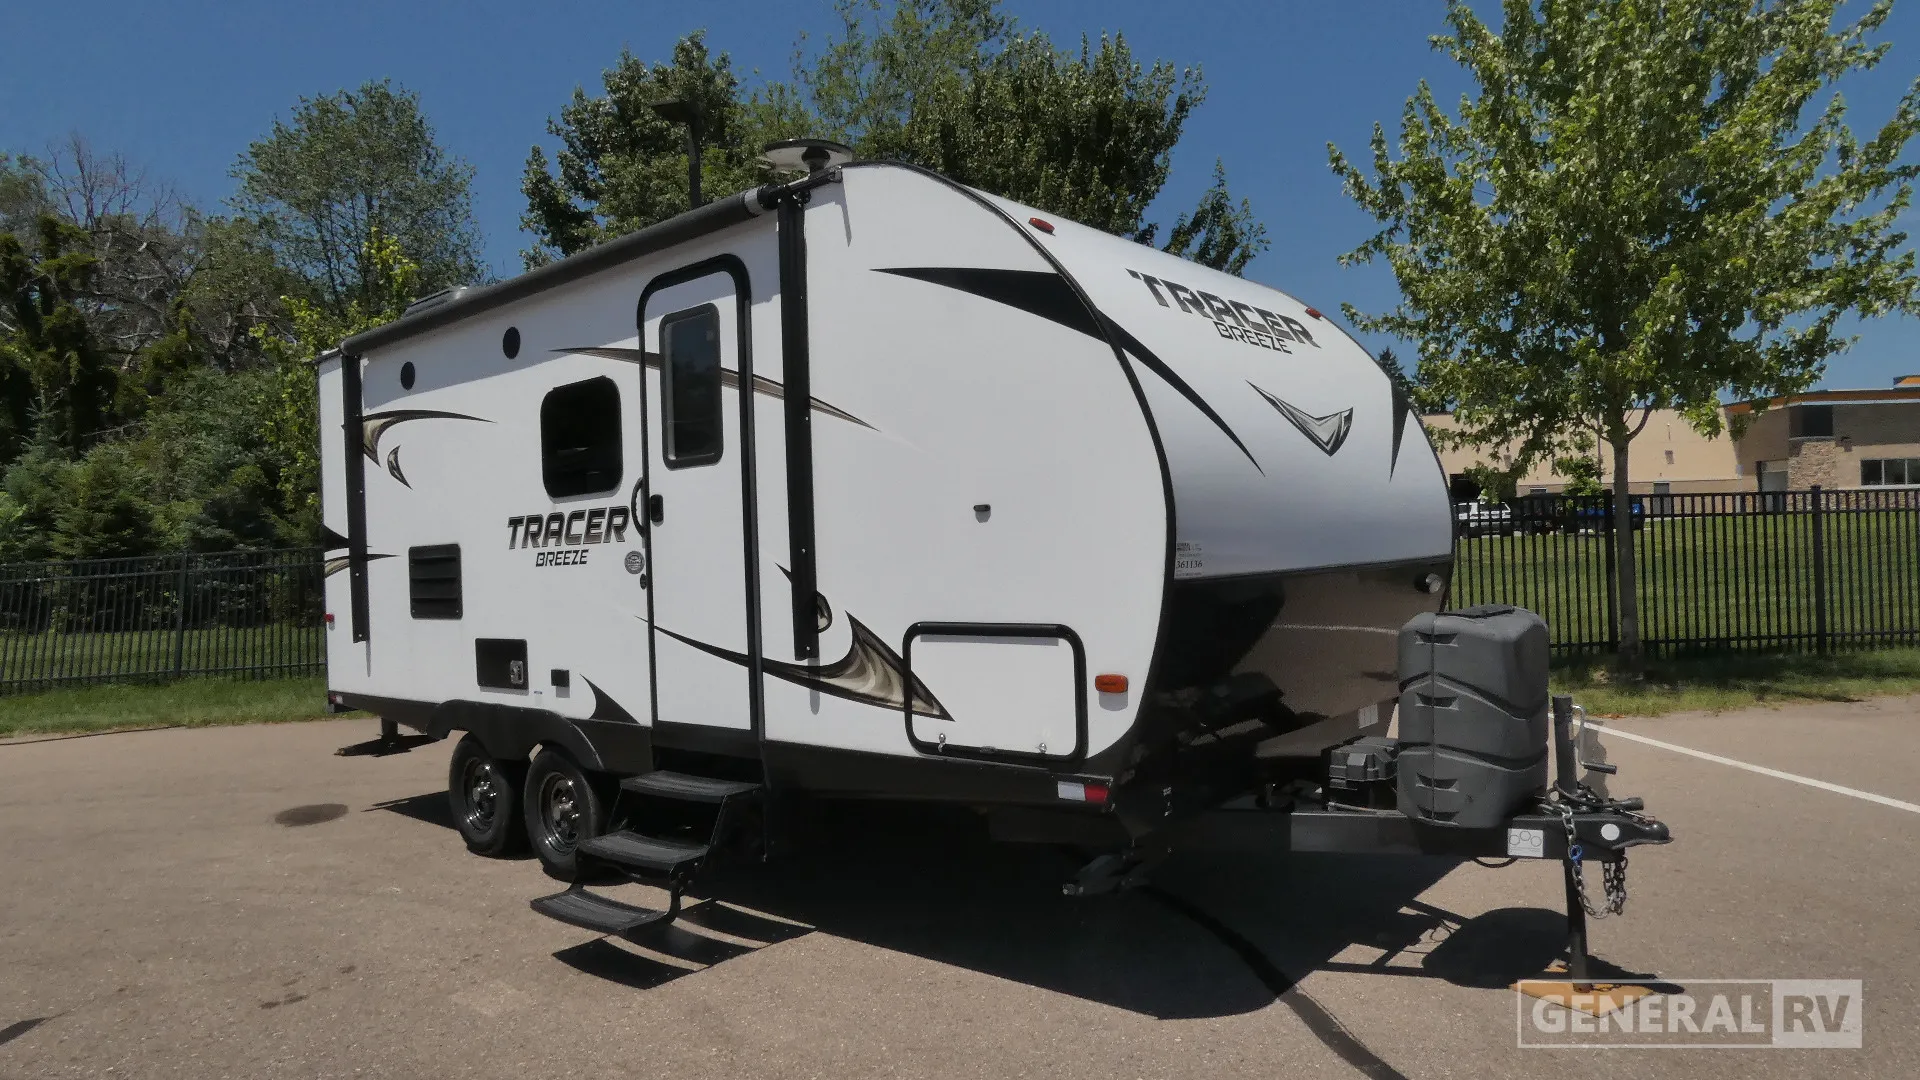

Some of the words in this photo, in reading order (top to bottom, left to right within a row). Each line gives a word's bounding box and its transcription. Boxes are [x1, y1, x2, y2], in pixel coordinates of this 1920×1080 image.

[1124, 267, 1322, 349] TRACER
[1212, 320, 1293, 355] BREEZE
[507, 505, 630, 550] TRACER
[535, 549, 590, 567] BREEZE
